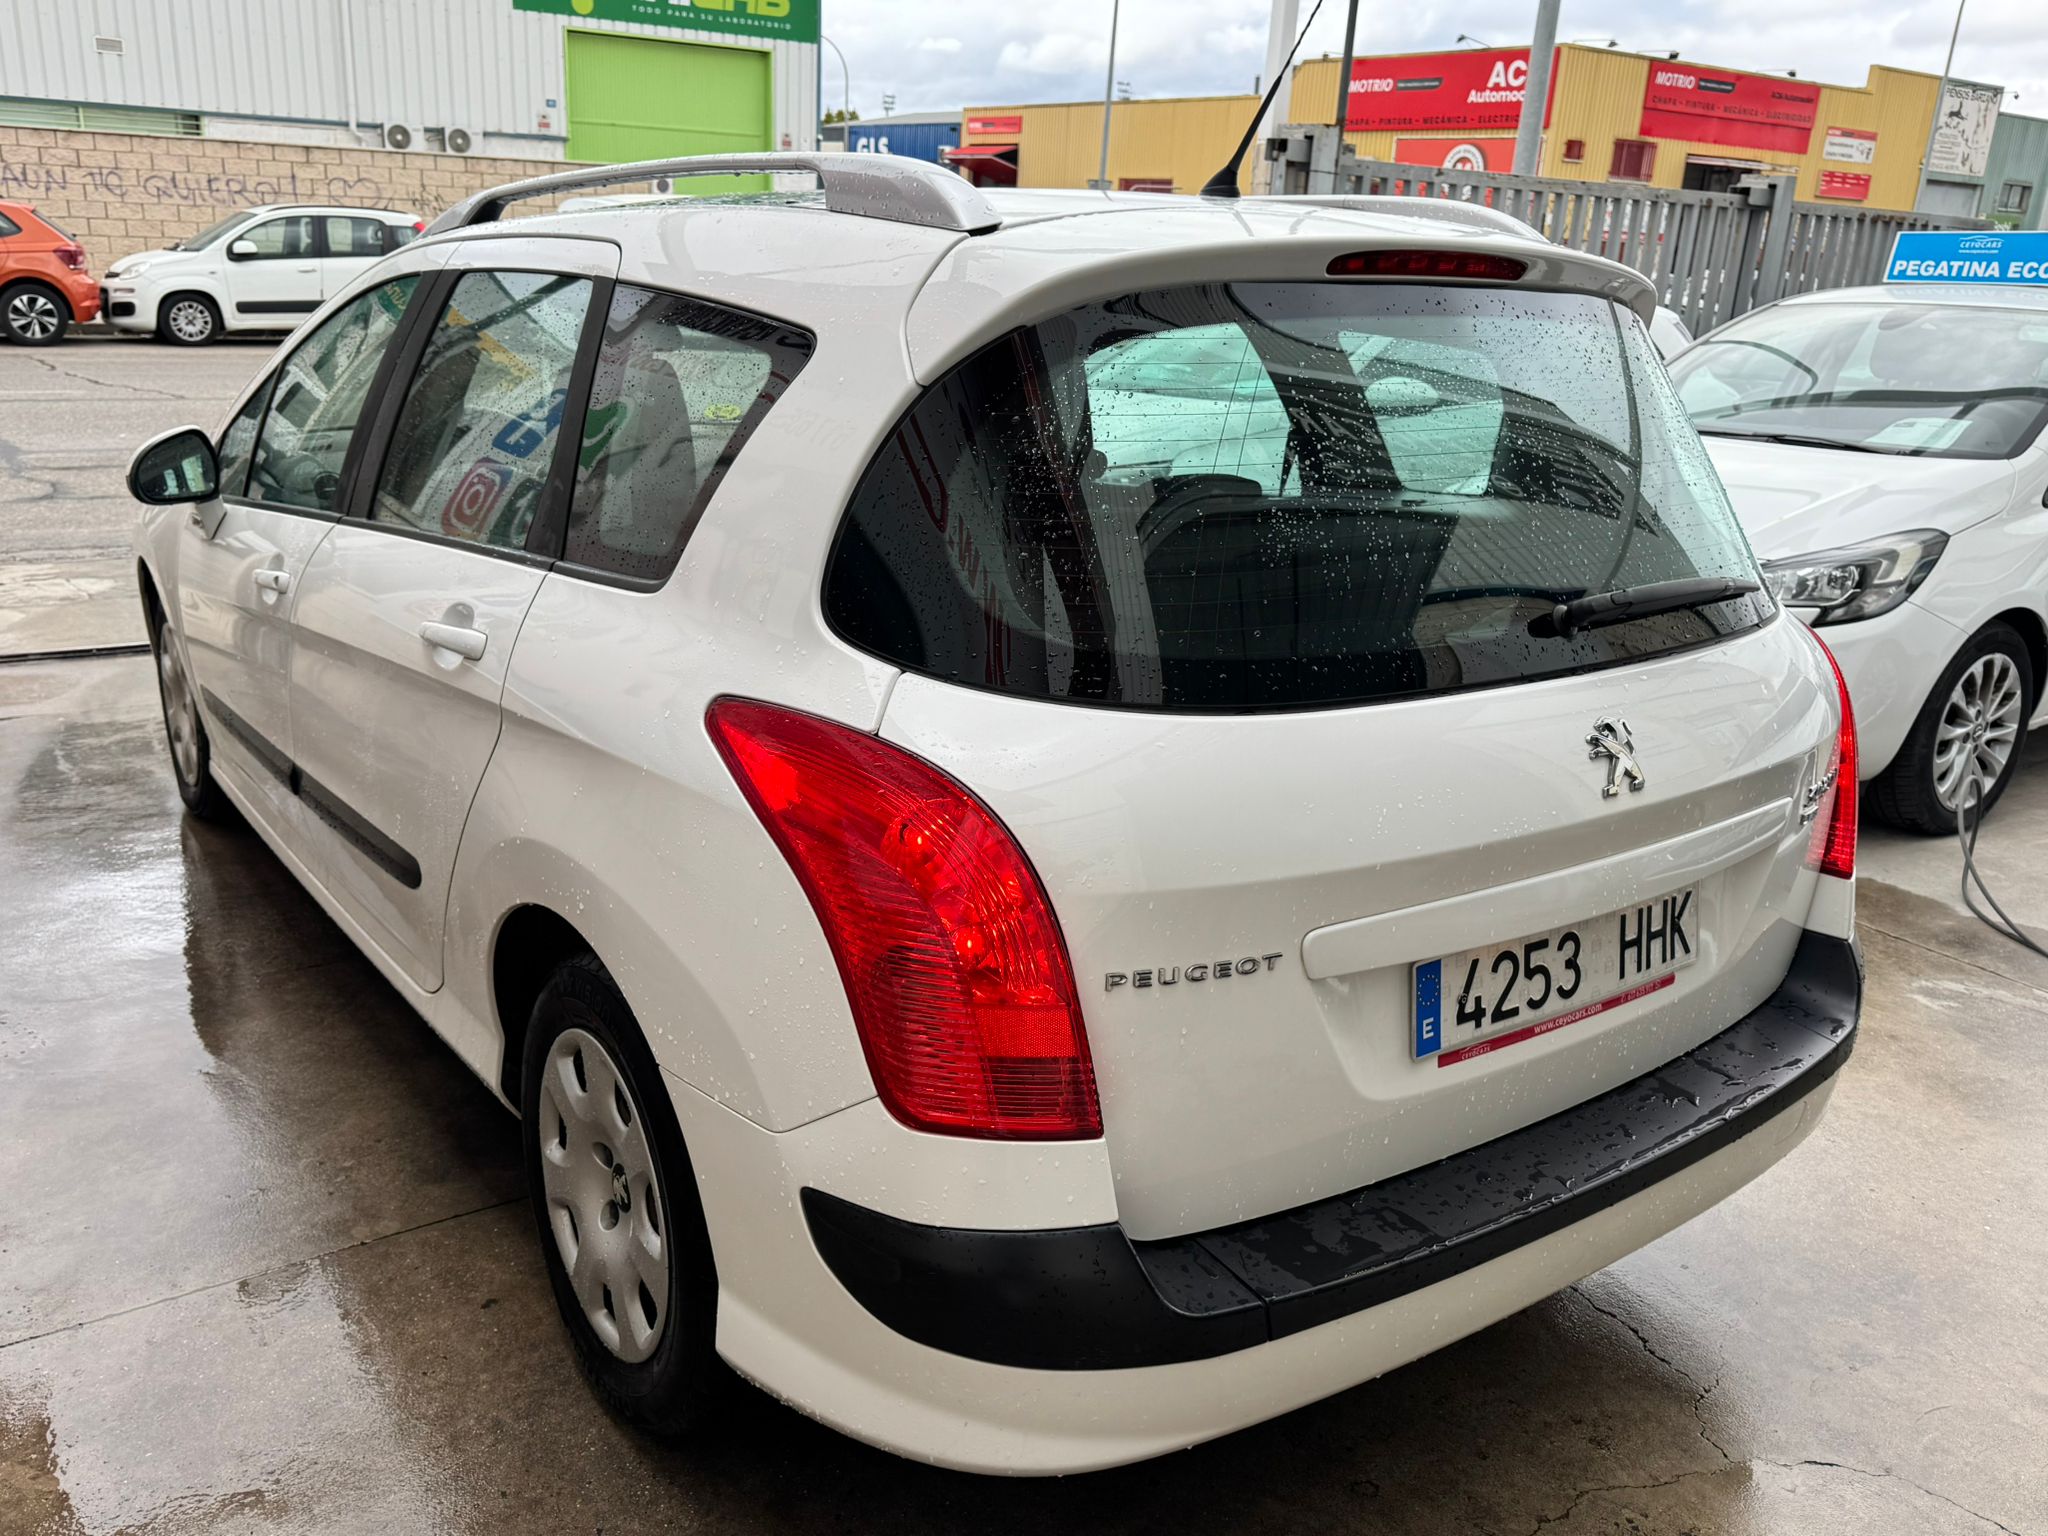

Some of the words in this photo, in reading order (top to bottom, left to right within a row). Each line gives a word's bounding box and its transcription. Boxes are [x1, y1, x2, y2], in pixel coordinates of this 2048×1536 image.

[631, 5, 662, 15] TODO
[667, 10, 695, 19] PARA
[700, 13, 714, 21] SU
[719, 16, 792, 30] LABORATORIO
[1348, 77, 1394, 93] MOTRIO
[1655, 71, 1696, 90] MOTRIO
[1892, 259, 2001, 278] PEGATINA
[1104, 951, 1283, 993] PEUGEOT
[1456, 931, 1582, 1030] 4253
[1619, 890, 1693, 981] HHK
[1422, 1017, 1434, 1040] E
[1534, 1003, 1602, 1034] www.ceyocars.com
